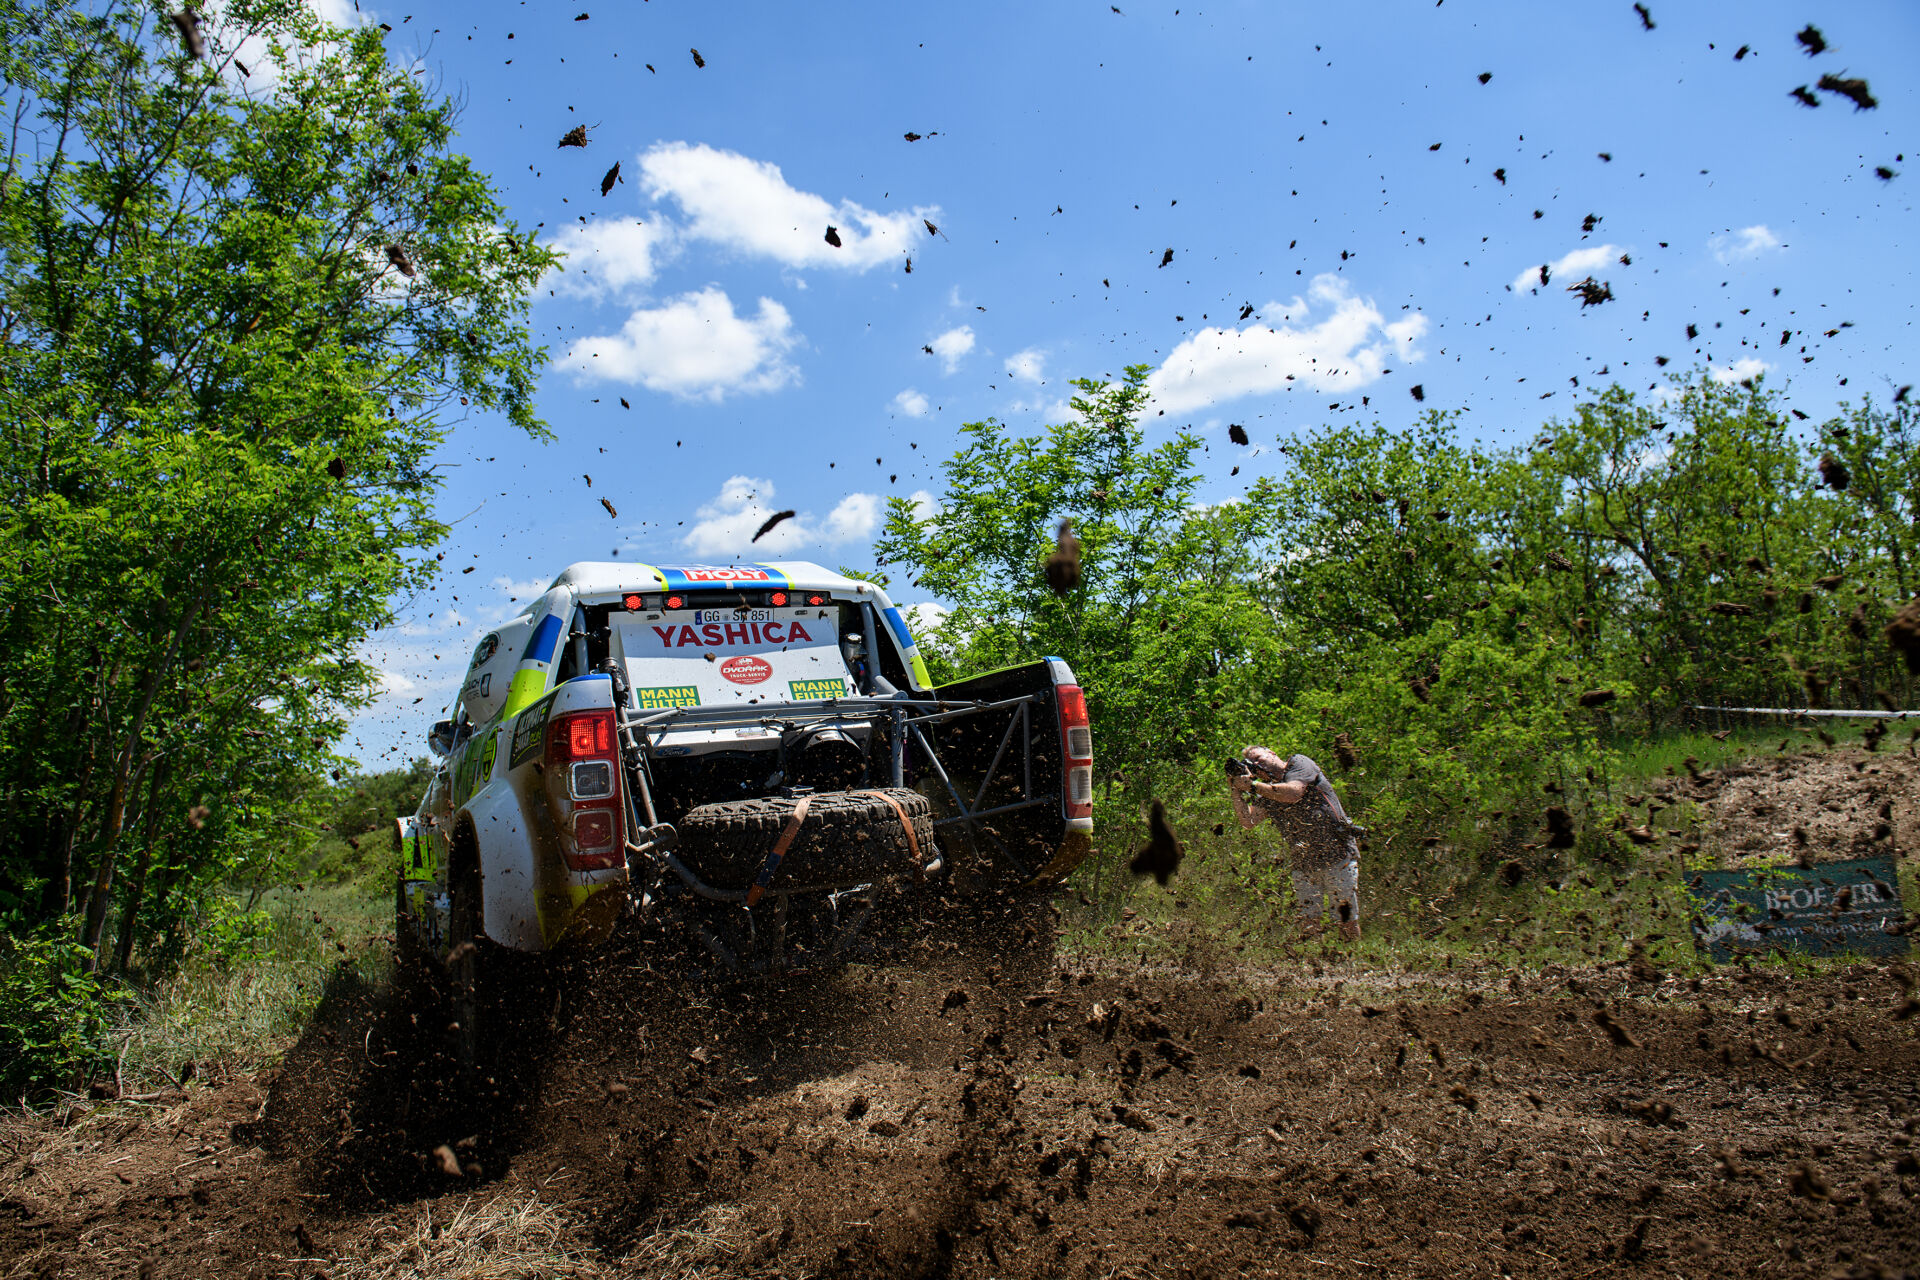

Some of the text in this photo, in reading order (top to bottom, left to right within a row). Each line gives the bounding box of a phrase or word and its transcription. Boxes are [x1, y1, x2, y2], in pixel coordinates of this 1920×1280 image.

[687, 570, 762, 580] MOLY
[704, 611, 720, 622] GG
[751, 610, 770, 621] 851
[652, 621, 813, 648] YASHICA
[792, 681, 843, 692] MANN
[640, 688, 695, 699] MANN
[642, 698, 697, 709] FILTER
